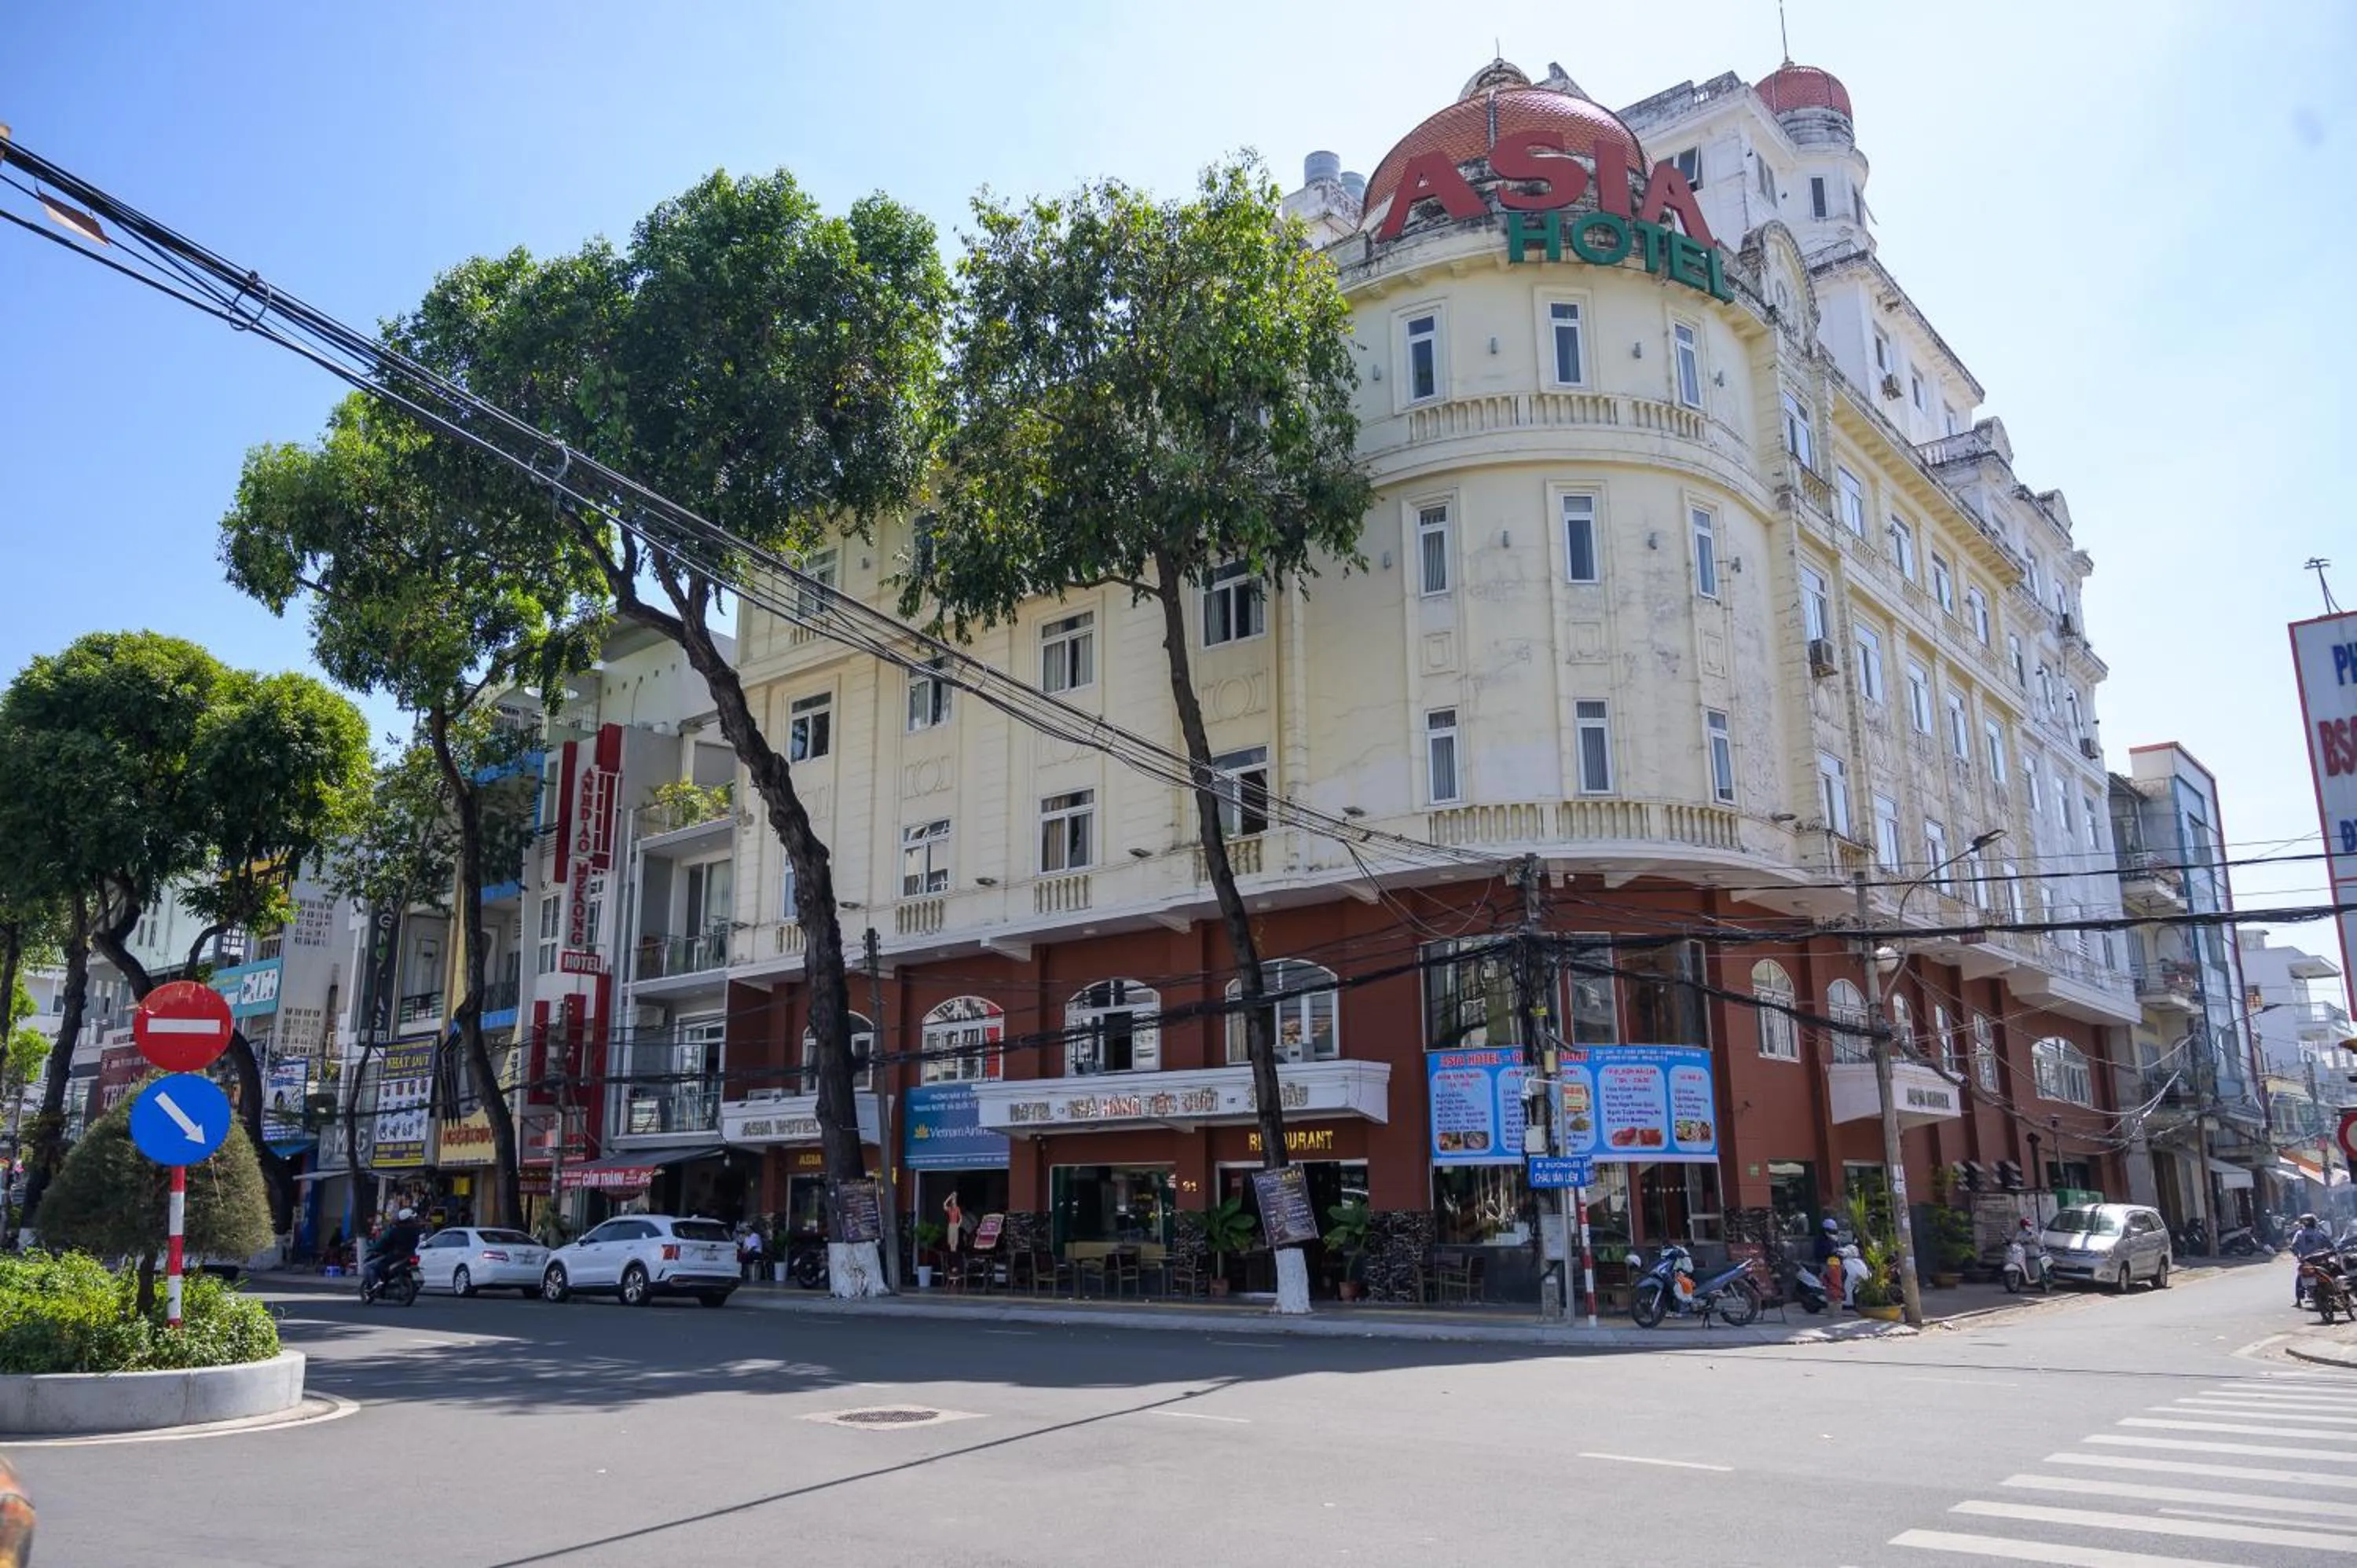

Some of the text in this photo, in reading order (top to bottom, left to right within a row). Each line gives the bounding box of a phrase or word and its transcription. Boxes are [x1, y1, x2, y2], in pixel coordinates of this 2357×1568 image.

[1376, 130, 1719, 248] ASIA
[1508, 209, 1735, 305] HOTEL
[571, 863, 588, 945] MEKONG
[565, 954, 600, 973] HOTEL
[361, 1030, 388, 1043] HTEL
